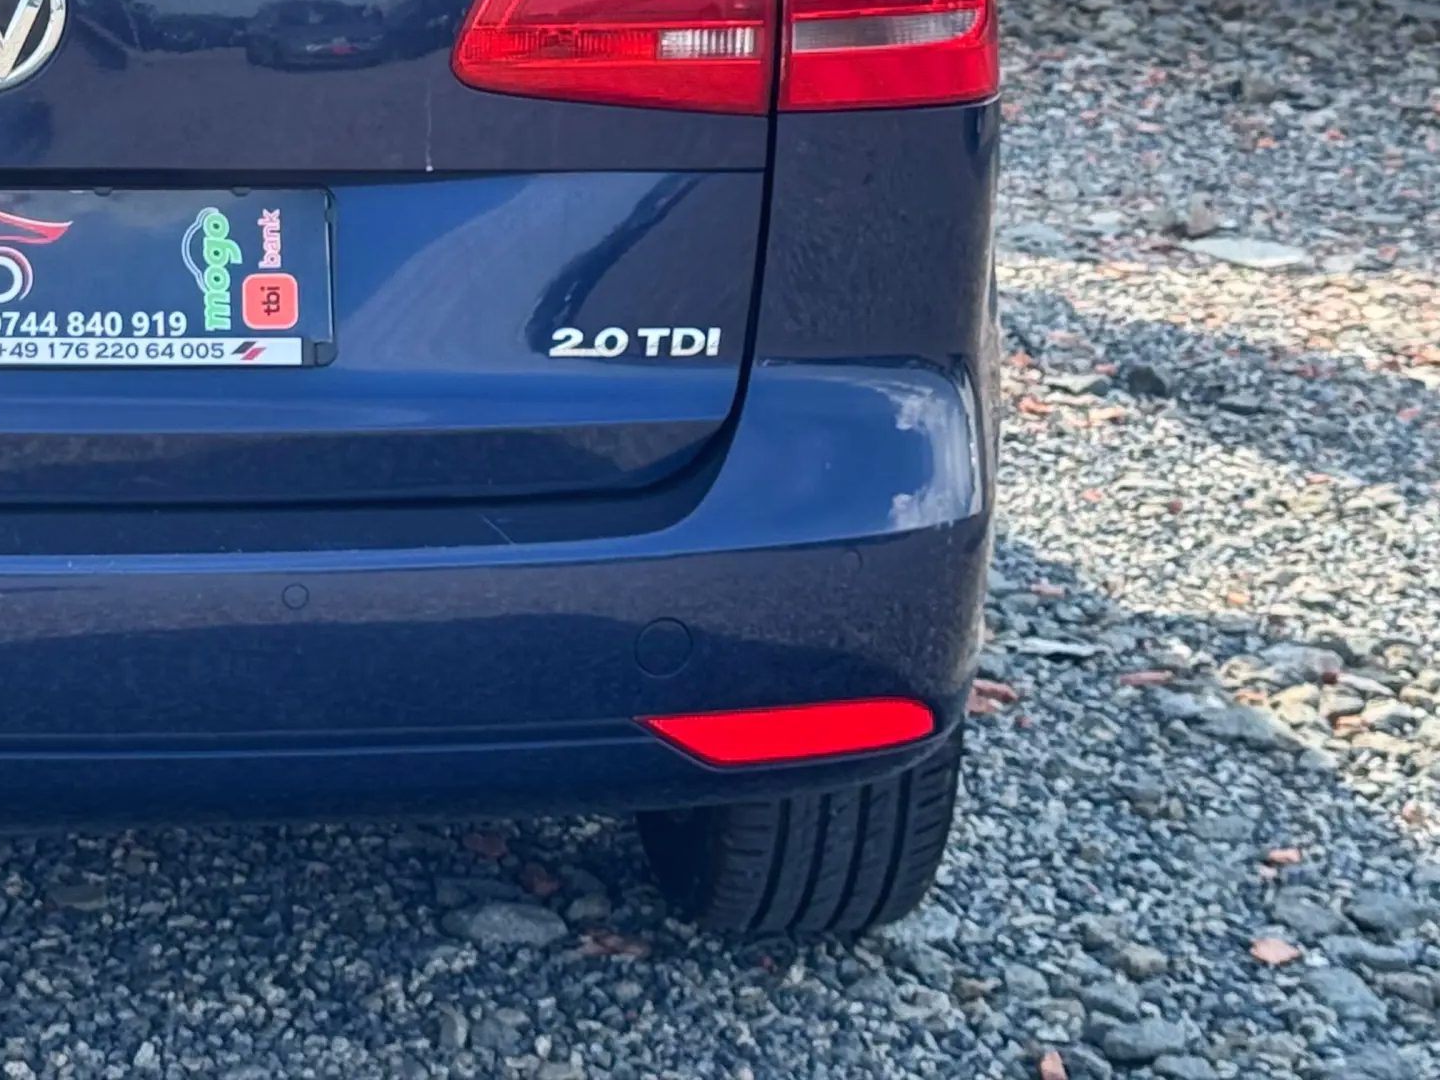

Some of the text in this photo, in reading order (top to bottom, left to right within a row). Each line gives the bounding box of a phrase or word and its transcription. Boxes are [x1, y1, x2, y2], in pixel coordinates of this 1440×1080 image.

[203, 210, 243, 332] mogo
[257, 208, 282, 316] tbi bank
[67, 310, 123, 337] 840
[131, 310, 188, 337] 919
[95, 341, 139, 359] 220
[145, 341, 176, 359] 64
[180, 341, 225, 359] 005
[637, 327, 721, 357] TDI
